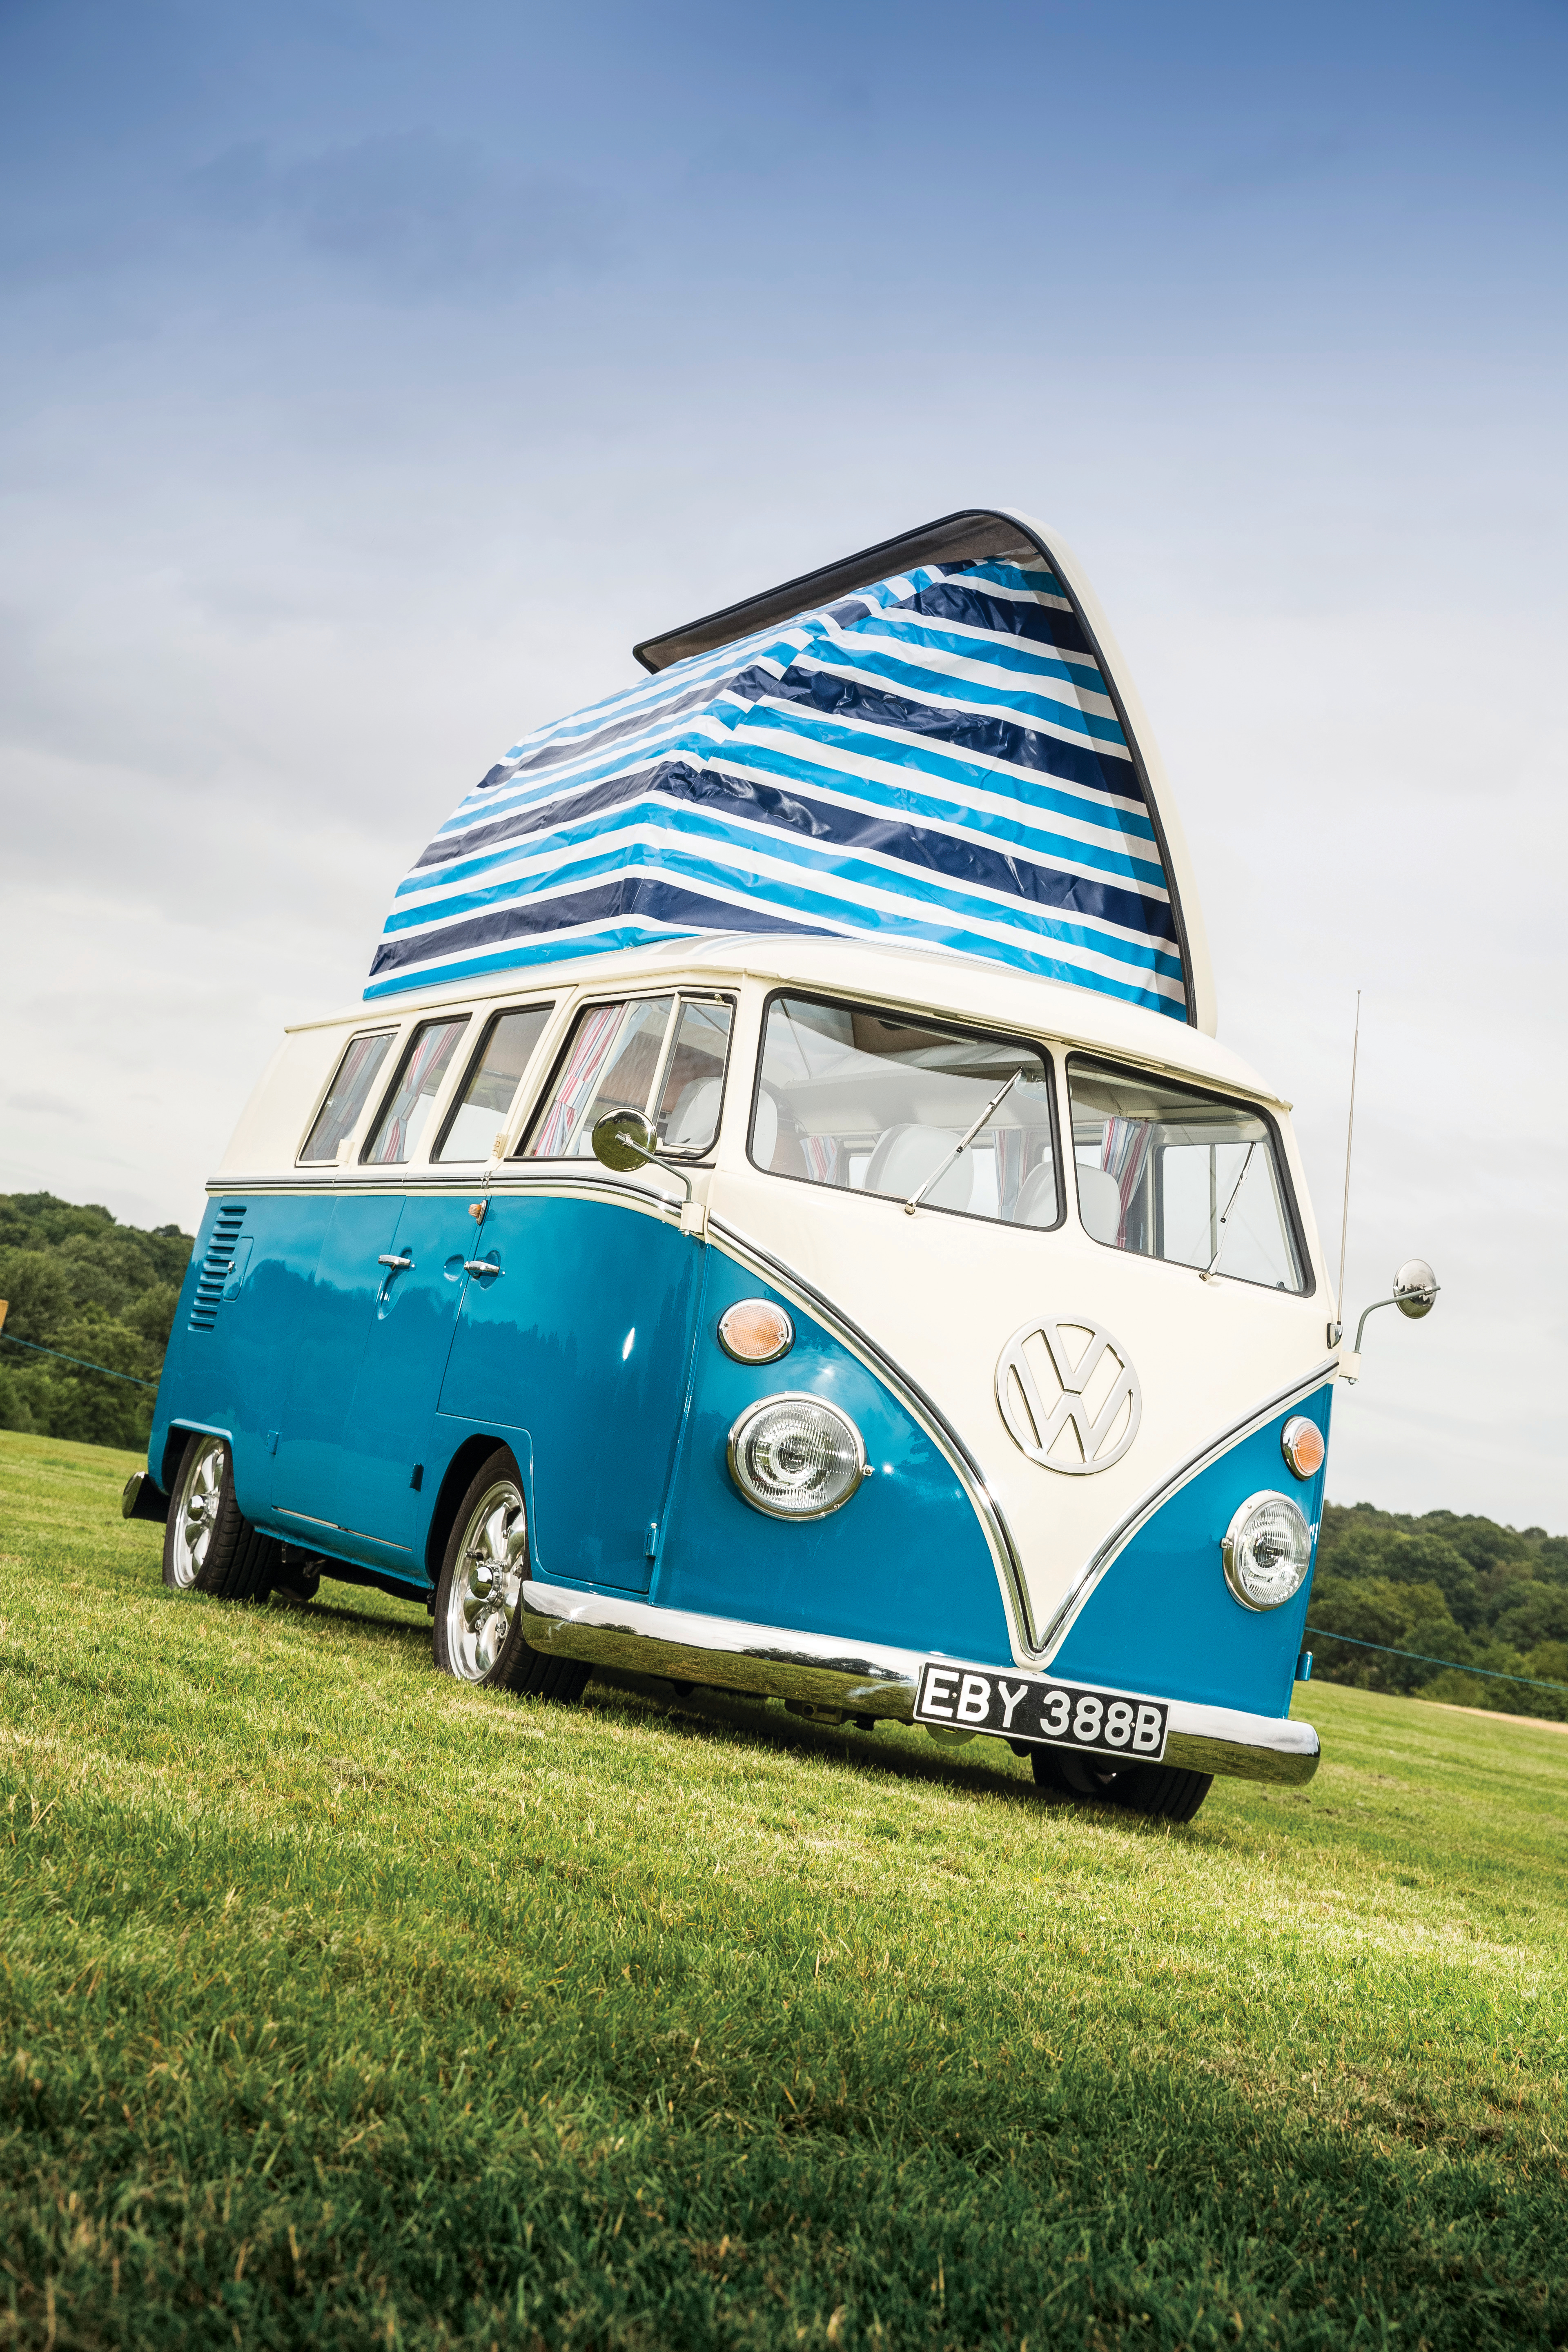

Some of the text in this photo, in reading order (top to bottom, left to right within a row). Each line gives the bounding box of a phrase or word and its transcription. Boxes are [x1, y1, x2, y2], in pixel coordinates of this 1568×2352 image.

[997, 1316, 1139, 1472] VW
[921, 1668, 1162, 1751] EBY 388B
